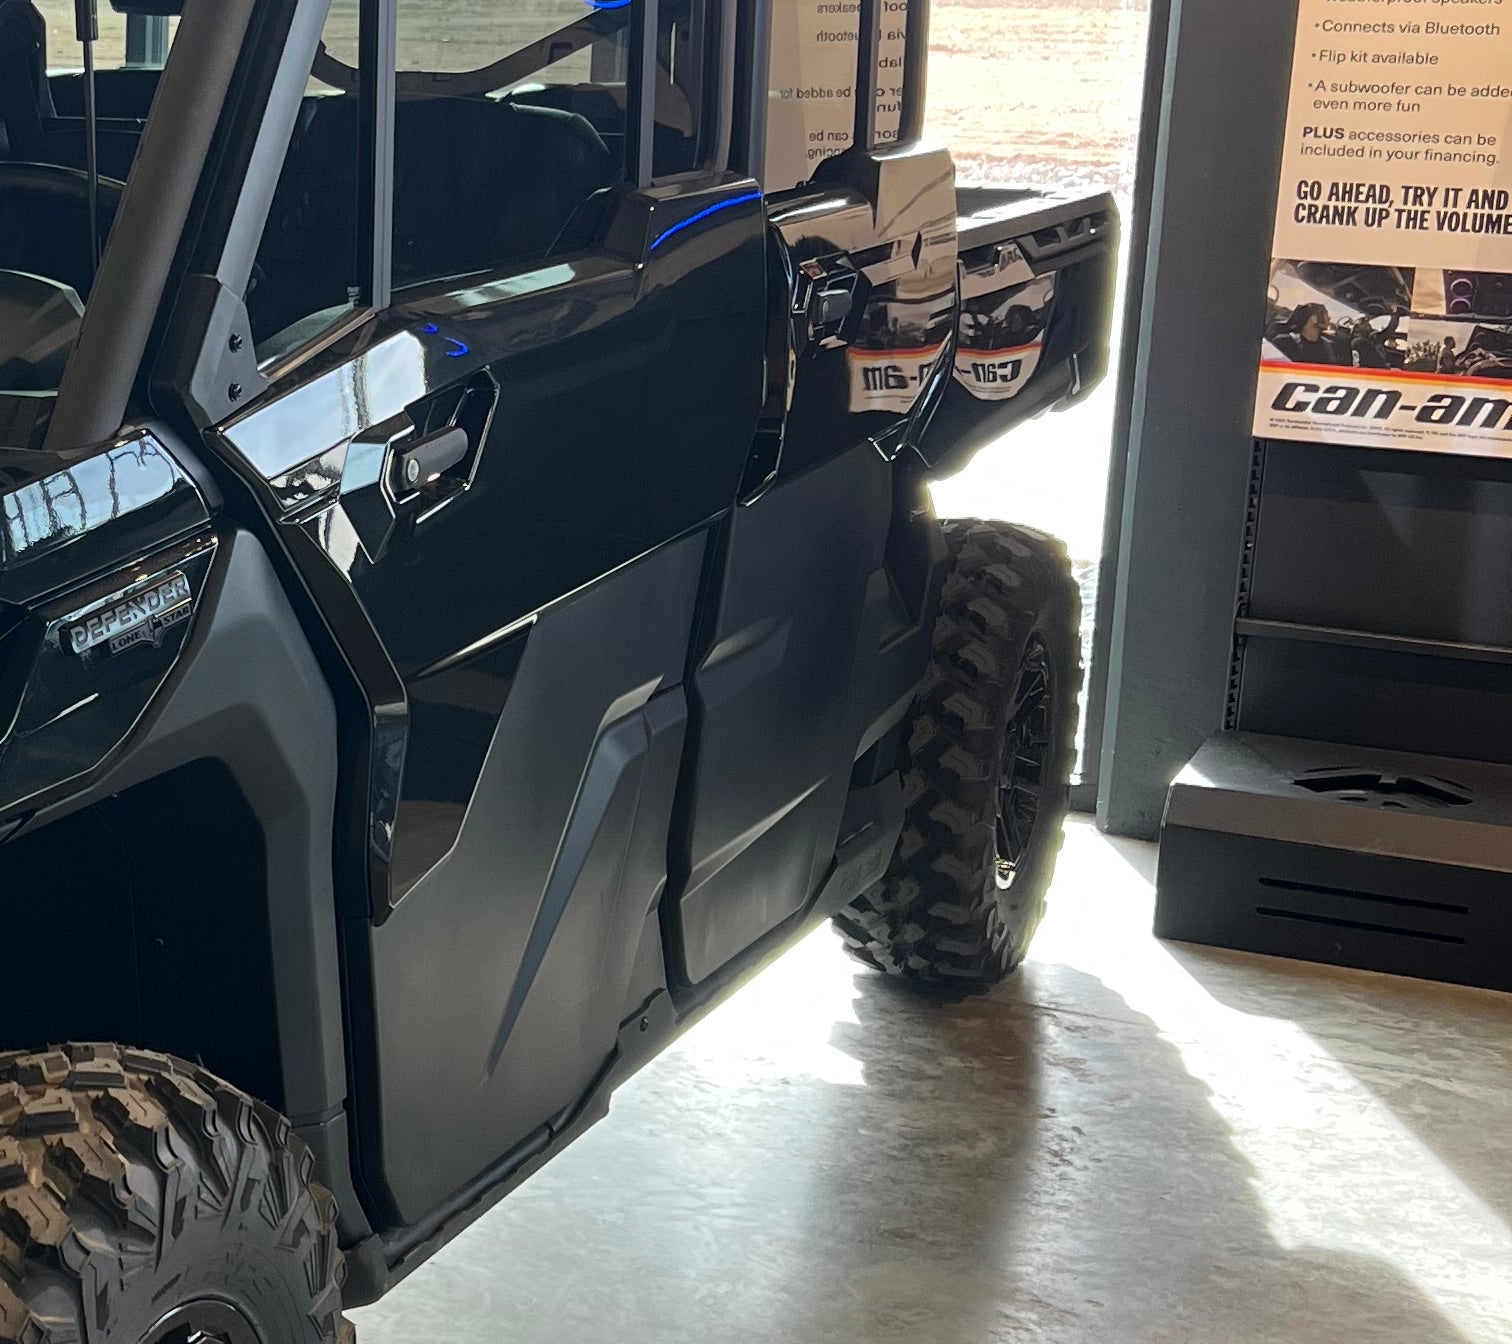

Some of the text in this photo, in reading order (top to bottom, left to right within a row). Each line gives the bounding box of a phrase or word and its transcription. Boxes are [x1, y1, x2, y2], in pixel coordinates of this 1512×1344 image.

[1322, 19, 1500, 36] Connects via Bluetooth
[1319, 49, 1439, 65] Flip kit available
[1315, 80, 1326, 92] A
[1330, 80, 1411, 95] subwoofer
[1414, 85, 1442, 96] can
[1447, 83, 1467, 96] be
[1313, 99, 1421, 113] even more fun
[1302, 126, 1497, 146] PLUS accessories can be
[1300, 143, 1500, 166] included in your financing.
[1296, 179, 1509, 210] GO AHEAD, TRY IT AND
[1294, 203, 1512, 234] CRANK UP THE VOLUME
[1271, 382, 1512, 431] can-am
[70, 577, 190, 647] DEFENDER
[112, 607, 190, 651] LONE STAR
